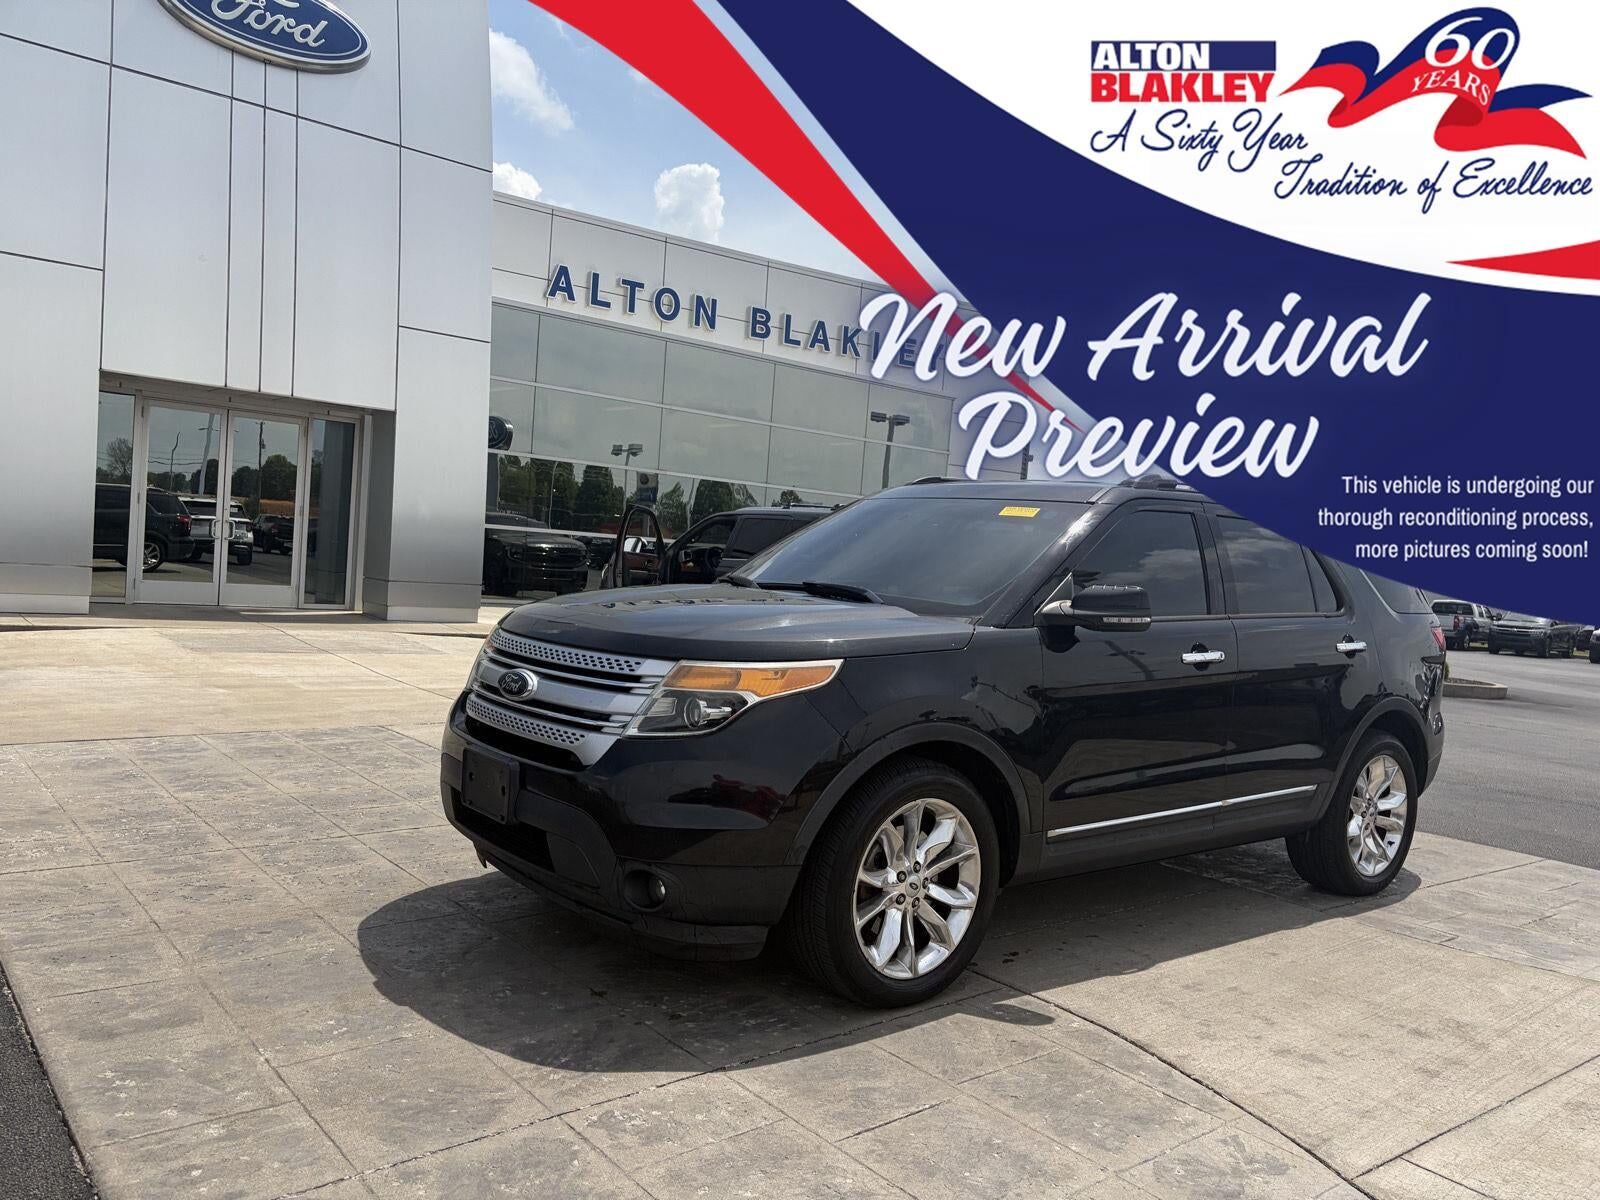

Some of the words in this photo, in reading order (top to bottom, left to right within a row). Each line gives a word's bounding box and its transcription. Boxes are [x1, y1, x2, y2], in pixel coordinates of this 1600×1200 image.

[210, 0, 328, 48] Ford
[546, 263, 718, 331] ALTON
[502, 673, 522, 692] Ford
